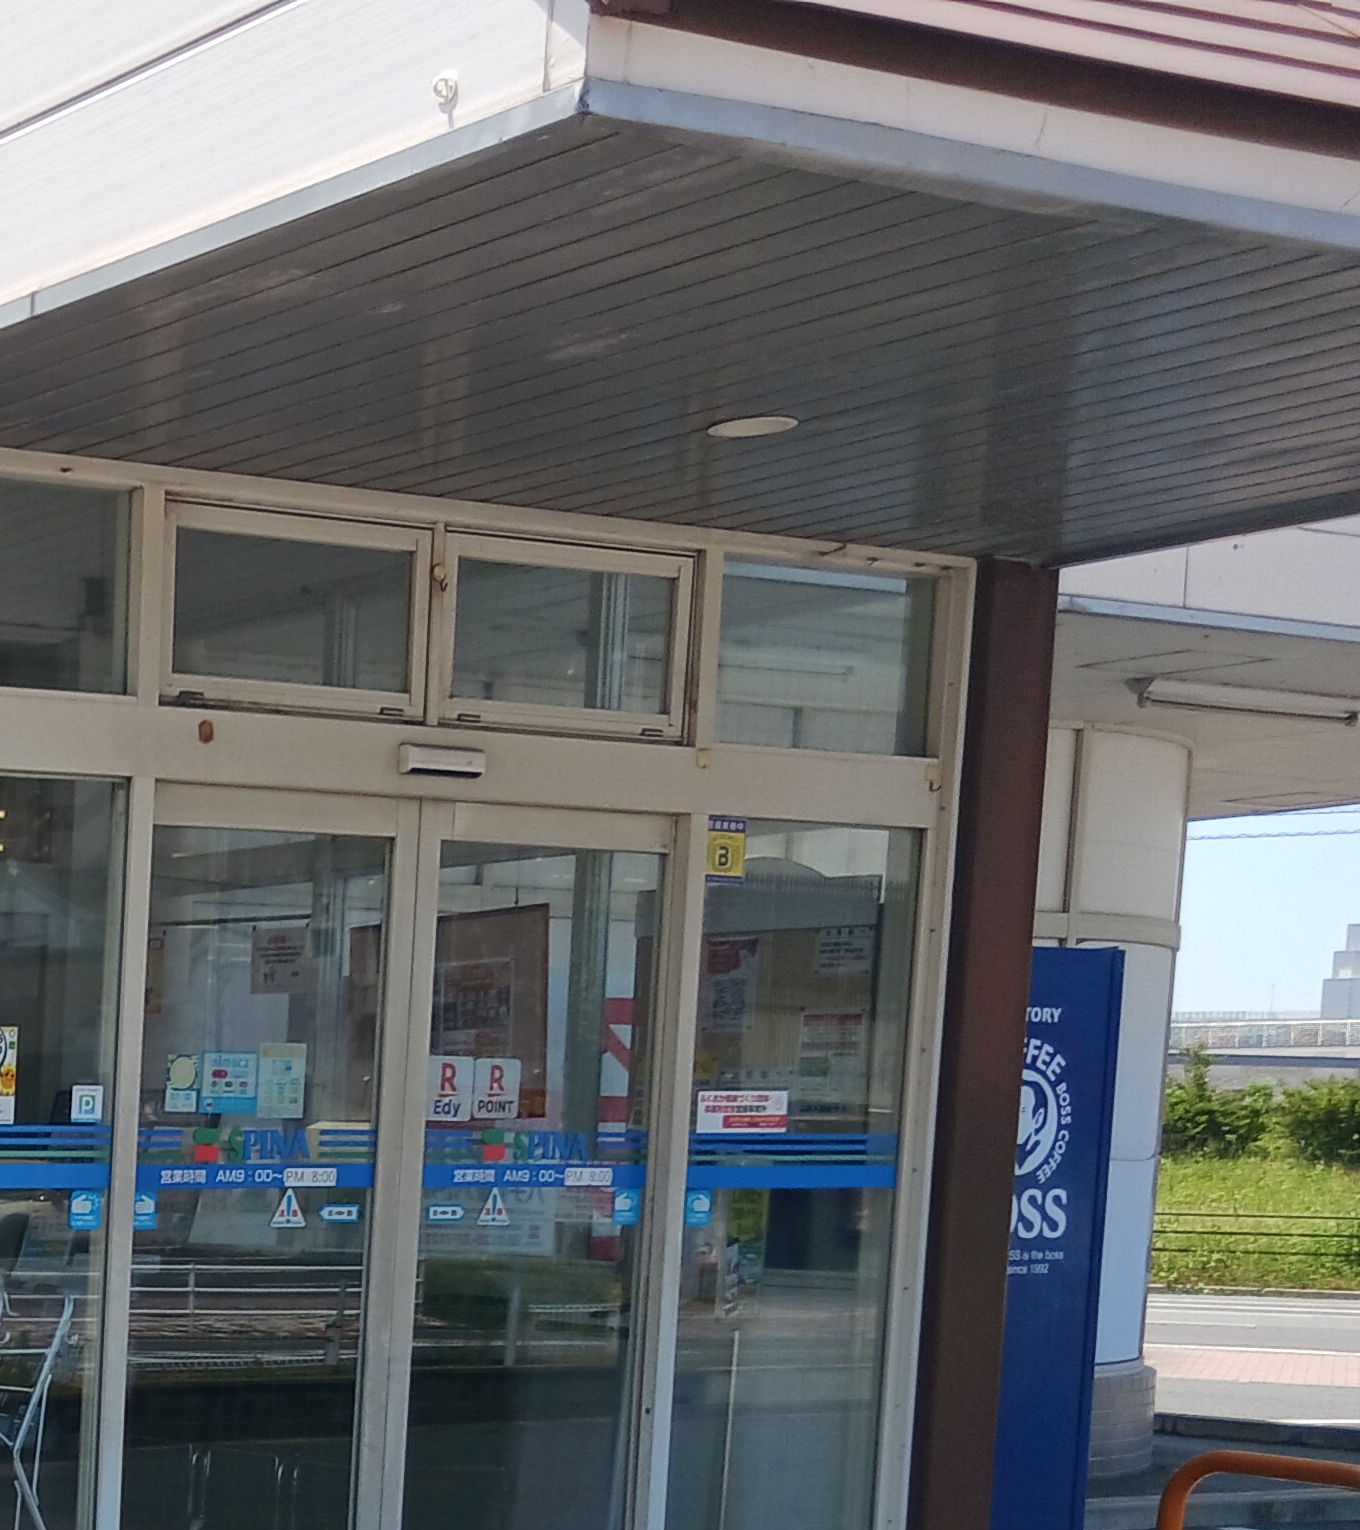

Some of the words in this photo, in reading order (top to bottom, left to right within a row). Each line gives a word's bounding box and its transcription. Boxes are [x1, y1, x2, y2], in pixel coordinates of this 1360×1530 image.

[440, 1062, 458, 1092] R
[490, 1064, 505, 1092] R
[433, 1100, 462, 1116] Edy
[477, 1100, 515, 1114] POINT
[1055, 1082, 1072, 1125] BOSS
[228, 1128, 310, 1163] SPINA
[513, 1130, 589, 1162] SPINA
[1036, 1130, 1070, 1184] COFFEE
[161, 1169, 207, 1184] 営業時間
[286, 1170, 305, 1182] PM
[311, 1170, 336, 1182] 8:00
